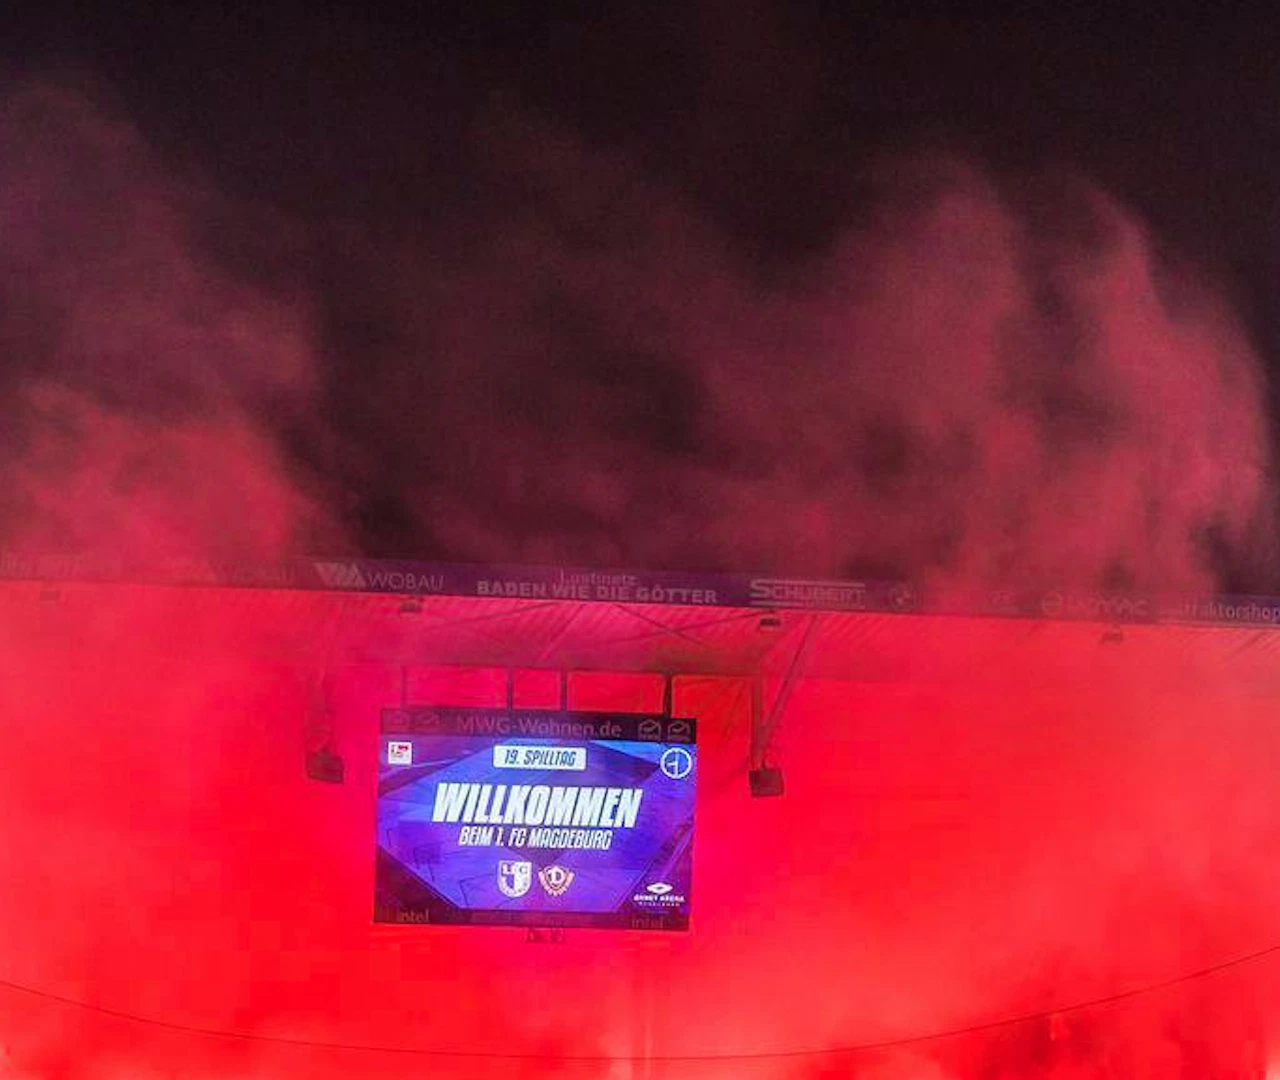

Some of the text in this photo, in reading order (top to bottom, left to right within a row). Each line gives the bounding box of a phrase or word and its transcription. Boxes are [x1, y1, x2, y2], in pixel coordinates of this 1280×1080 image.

[369, 572, 444, 591] WOBAU
[477, 580, 718, 604] BADEN WIE DIE GÖTTER
[456, 716, 622, 738] MWG-Wohnen.de
[503, 750, 576, 766] 19. SPIELTAG
[431, 783, 643, 828] WILLKOMMEN
[458, 827, 495, 846] BEIM
[508, 829, 526, 847] FC
[528, 829, 613, 850] MAGDEBURG
